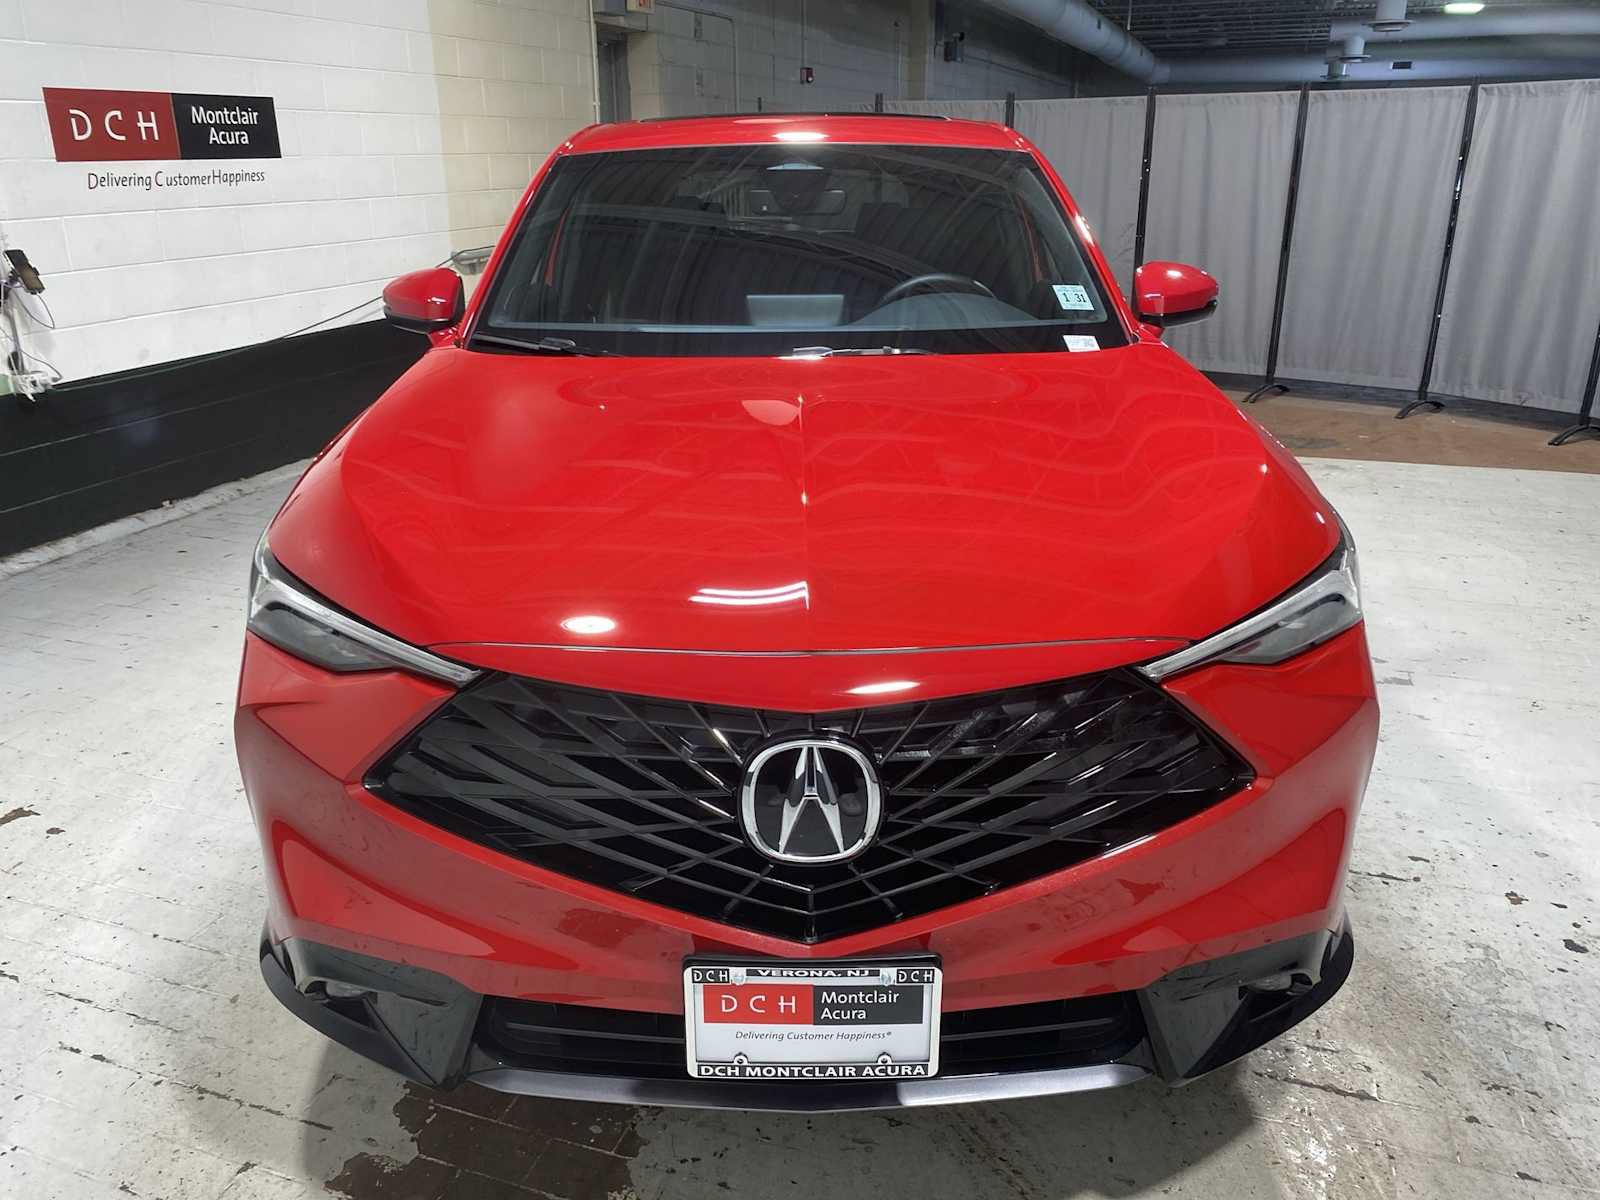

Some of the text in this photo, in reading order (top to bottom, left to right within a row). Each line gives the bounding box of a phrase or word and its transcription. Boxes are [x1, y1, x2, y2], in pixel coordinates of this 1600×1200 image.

[191, 105, 259, 126] Montclair
[209, 126, 250, 145] Acura
[87, 172, 152, 190] Delivering
[1074, 293, 1087, 303] 31
[692, 968, 729, 982] DCH
[897, 969, 934, 982] DCH
[820, 990, 900, 1004] Montclair
[820, 1007, 867, 1020] Acura
[735, 1030, 785, 1042] Delivering
[786, 1031, 833, 1041] Customer
[700, 1064, 926, 1077] DCH MONTCLAIR ACURA
